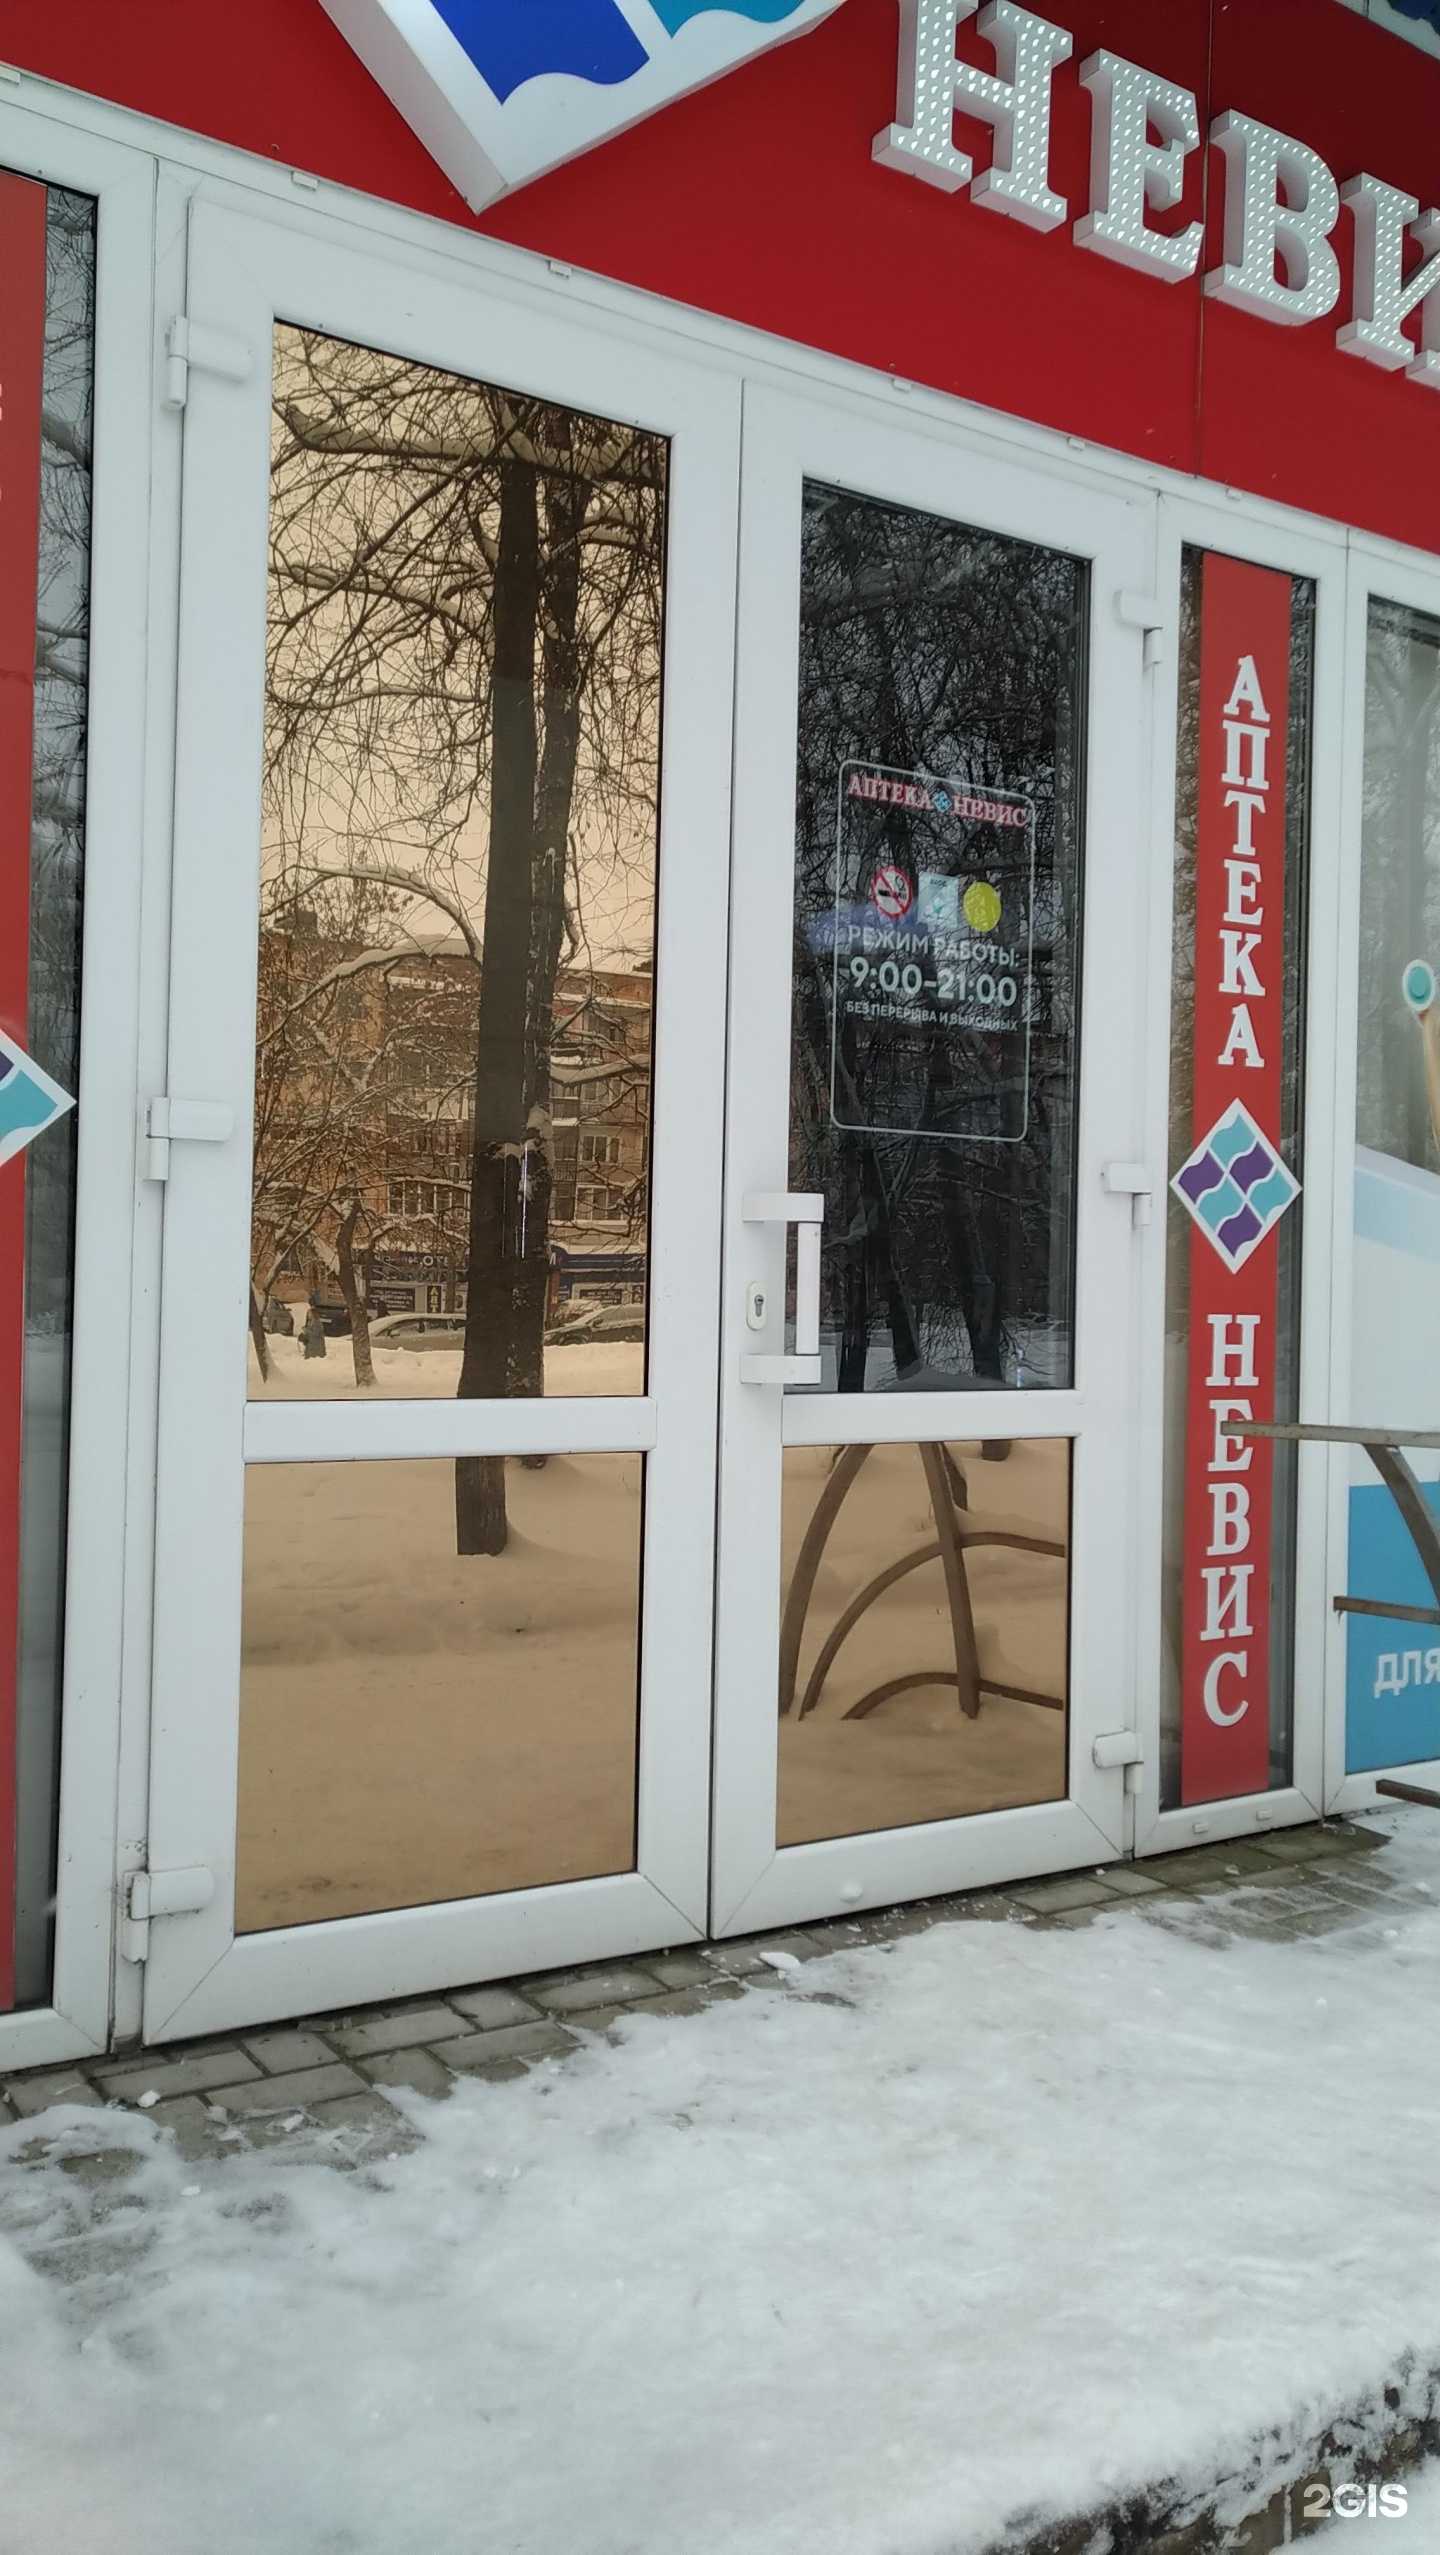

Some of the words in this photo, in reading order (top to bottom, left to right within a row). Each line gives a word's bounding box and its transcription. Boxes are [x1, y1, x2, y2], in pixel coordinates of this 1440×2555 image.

[848, 775, 934, 811] АПТЕКА
[951, 795, 1028, 828] НЕВИС
[1218, 655, 1270, 1068] АПТЕКА
[848, 925, 929, 955] РЕЖИМ
[934, 937, 1021, 968] РАБОТЫ:
[850, 956, 1018, 1007] 9:00-21:00
[846, 1000, 869, 1015] БЕЗ
[871, 1003, 937, 1024] ПЕРЕРЫВА
[939, 1012, 949, 1023] И
[951, 1013, 1019, 1032] ВЫХОДНЫХ
[1200, 1313, 1261, 1728] НЕВИС
